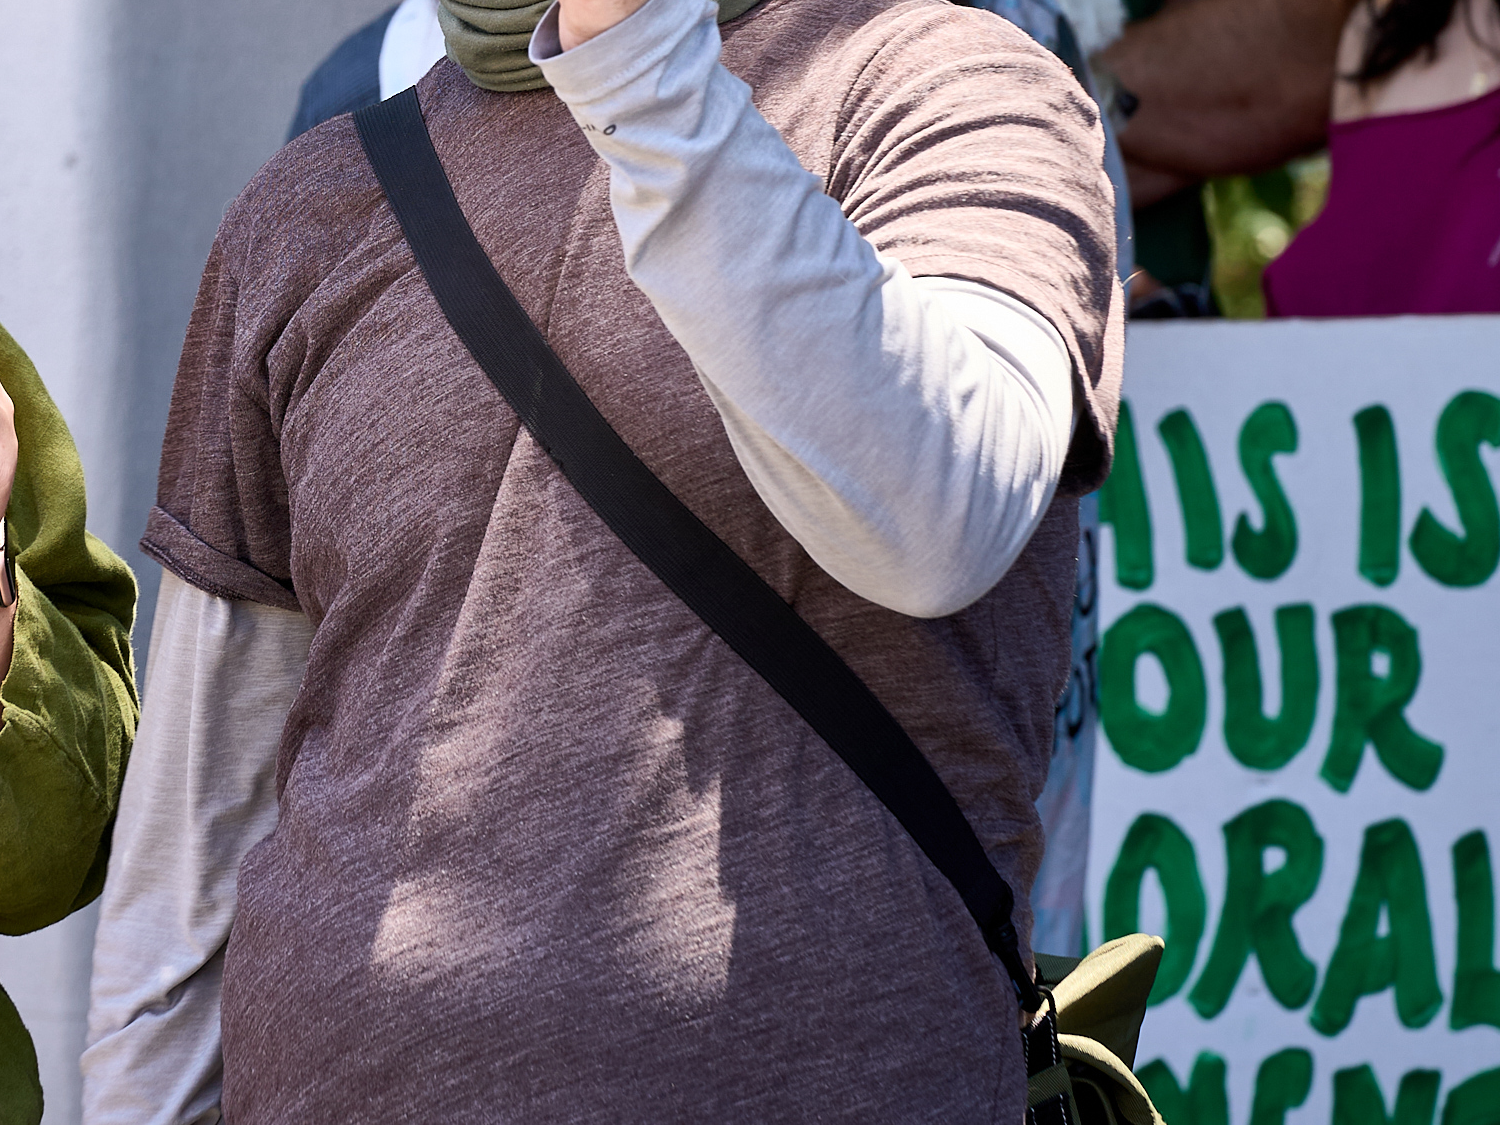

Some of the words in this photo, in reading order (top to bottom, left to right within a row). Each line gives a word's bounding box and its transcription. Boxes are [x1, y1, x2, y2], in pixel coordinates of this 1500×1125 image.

[1353, 389, 1500, 589] IS
[1097, 602, 1445, 794] OUR
[1083, 798, 1500, 1037] ORAL
